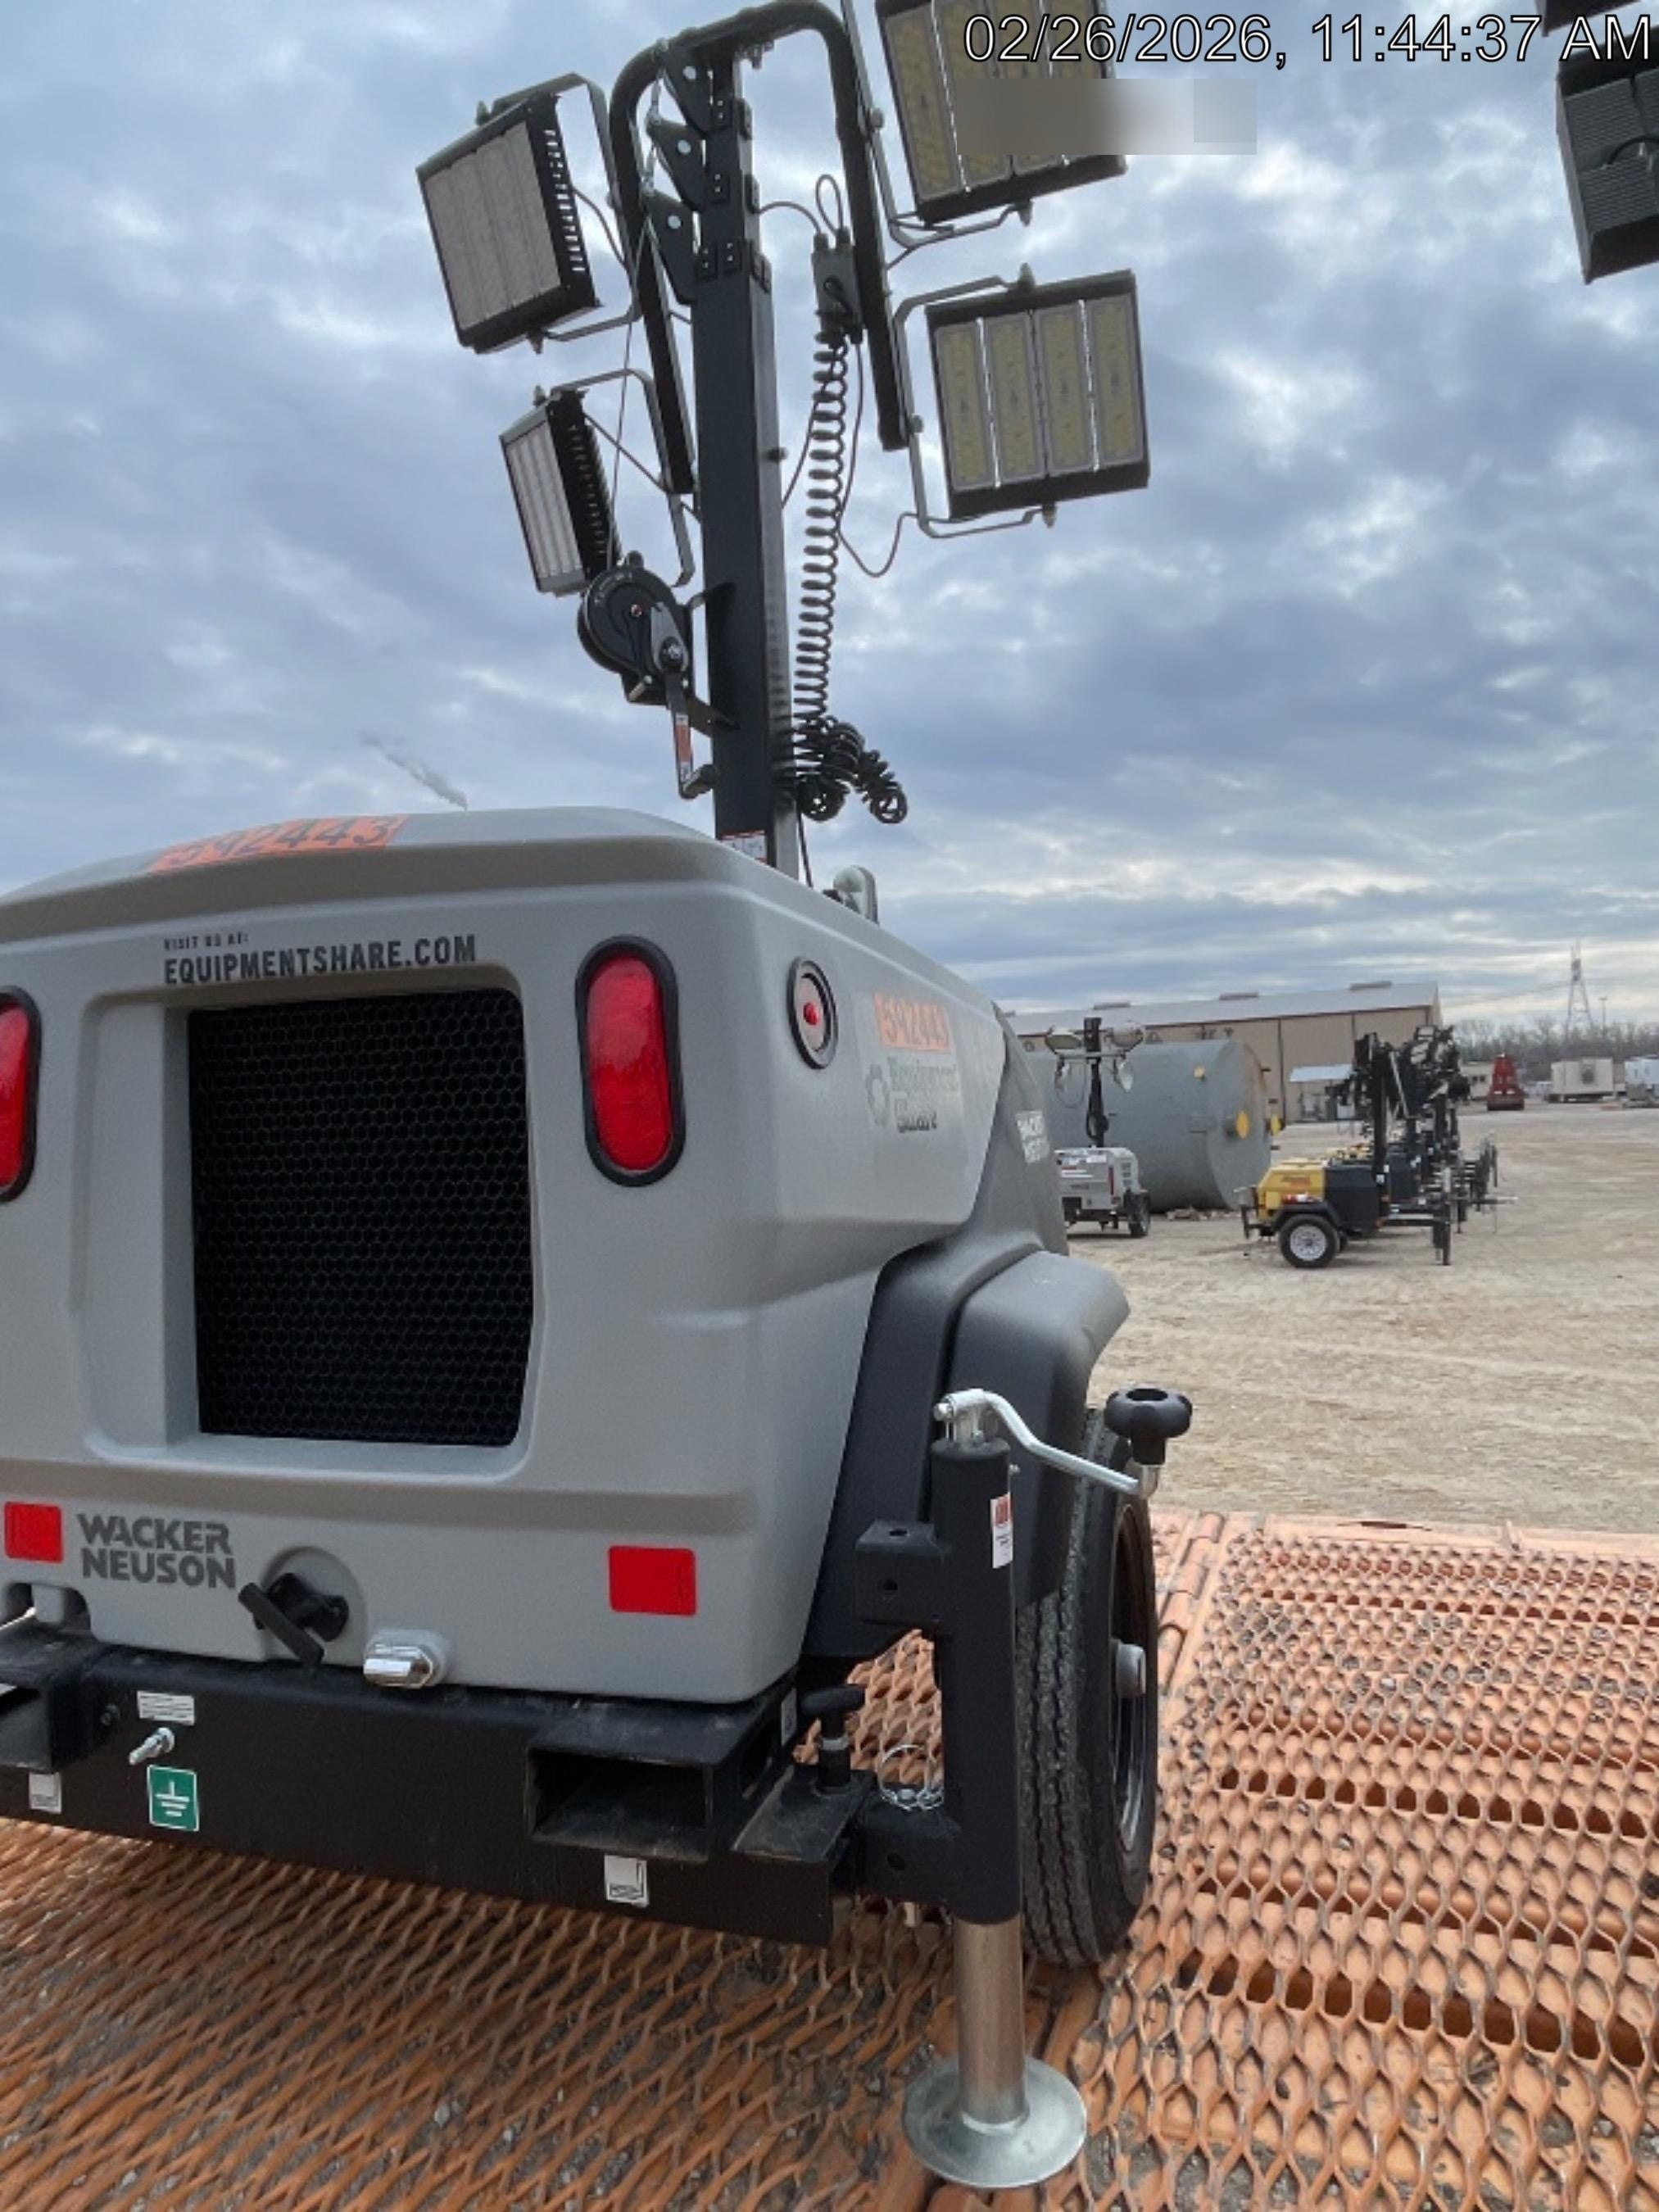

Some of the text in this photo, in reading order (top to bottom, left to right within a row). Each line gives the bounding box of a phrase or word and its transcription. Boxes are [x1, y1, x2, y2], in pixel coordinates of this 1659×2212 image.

[164, 933, 476, 985] EQUIPMENTSHARE.COM
[77, 1513, 233, 1556] WACKER
[82, 1548, 238, 1589] NEUSON
